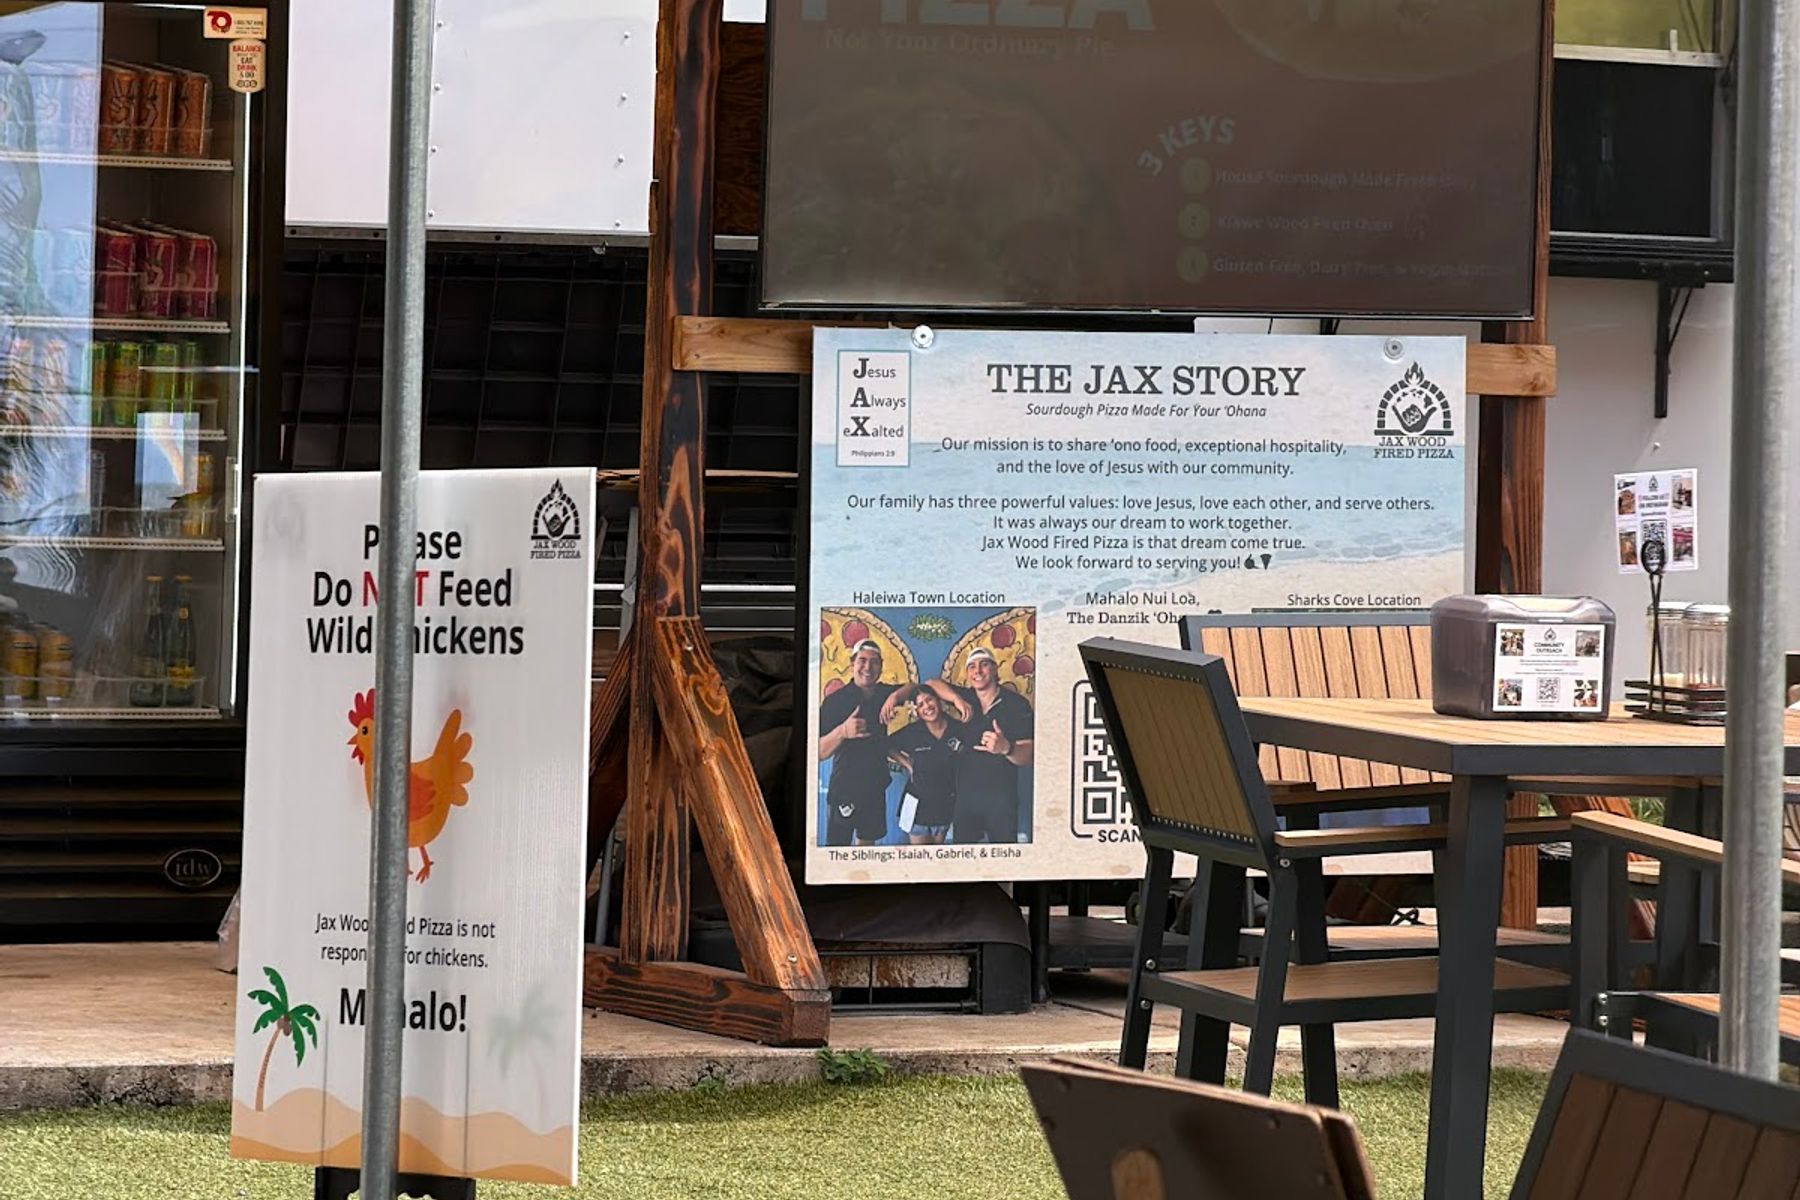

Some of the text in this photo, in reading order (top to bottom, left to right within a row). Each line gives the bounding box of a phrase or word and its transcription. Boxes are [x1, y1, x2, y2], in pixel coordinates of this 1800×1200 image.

[1136, 150, 1164, 176] 3
[1157, 113, 1237, 157] KEYS
[853, 358, 896, 379] Jesus
[987, 364, 1306, 396] THE JAX STORY
[850, 387, 906, 408] Always
[1026, 403, 1093, 419] Sourdough
[1097, 404, 1128, 416] Pizza
[1132, 404, 1166, 416] Made
[1169, 404, 1190, 416] For
[1194, 404, 1221, 416] Your
[843, 416, 904, 437] eXalted
[942, 437, 969, 452] Our
[974, 437, 1028, 451] mission
[1034, 438, 1044, 451] is
[1048, 440, 1063, 451] to
[1067, 438, 1107, 451] share
[1145, 438, 1180, 454] food,
[1185, 439, 1266, 456] exceptional
[1270, 439, 1346, 456] hospitality,
[1379, 436, 1448, 448] JAX WOOD
[1374, 449, 1454, 458] FIRED PIZZA
[996, 460, 1294, 477] and the love of Jesus with our community.
[848, 494, 1434, 512] Our family has three powerful values: love Jesus, love each other, and serve others.
[994, 515, 1291, 531] It was always our dream to work together.
[363, 524, 462, 560] Pase
[533, 540, 577, 549] JAX WOOD
[981, 535, 1306, 552] Jax Wood Fired Pizza is that dream come true.
[1016, 555, 1240, 572] We look forward to serving you!
[313, 568, 512, 607] Do NT Feed
[854, 591, 1005, 604] Haleiwa Town Location
[1086, 591, 1138, 605] Mahalo
[1143, 592, 1166, 604] Nui
[1288, 594, 1421, 606] Sharks Cove Location
[1067, 612, 1094, 624] The
[1098, 612, 1149, 624] Danzik
[307, 616, 524, 654] Wild ickens
[829, 848, 1021, 862] The Siblings: Isaiah, Gabriel, & Elisha
[315, 913, 336, 934] Jax
[339, 914, 369, 932] Woo
[419, 918, 453, 936] Pizza
[457, 919, 468, 937] is
[472, 921, 495, 939] not
[425, 947, 488, 968] chickens.
[339, 988, 467, 1032] Malo!
